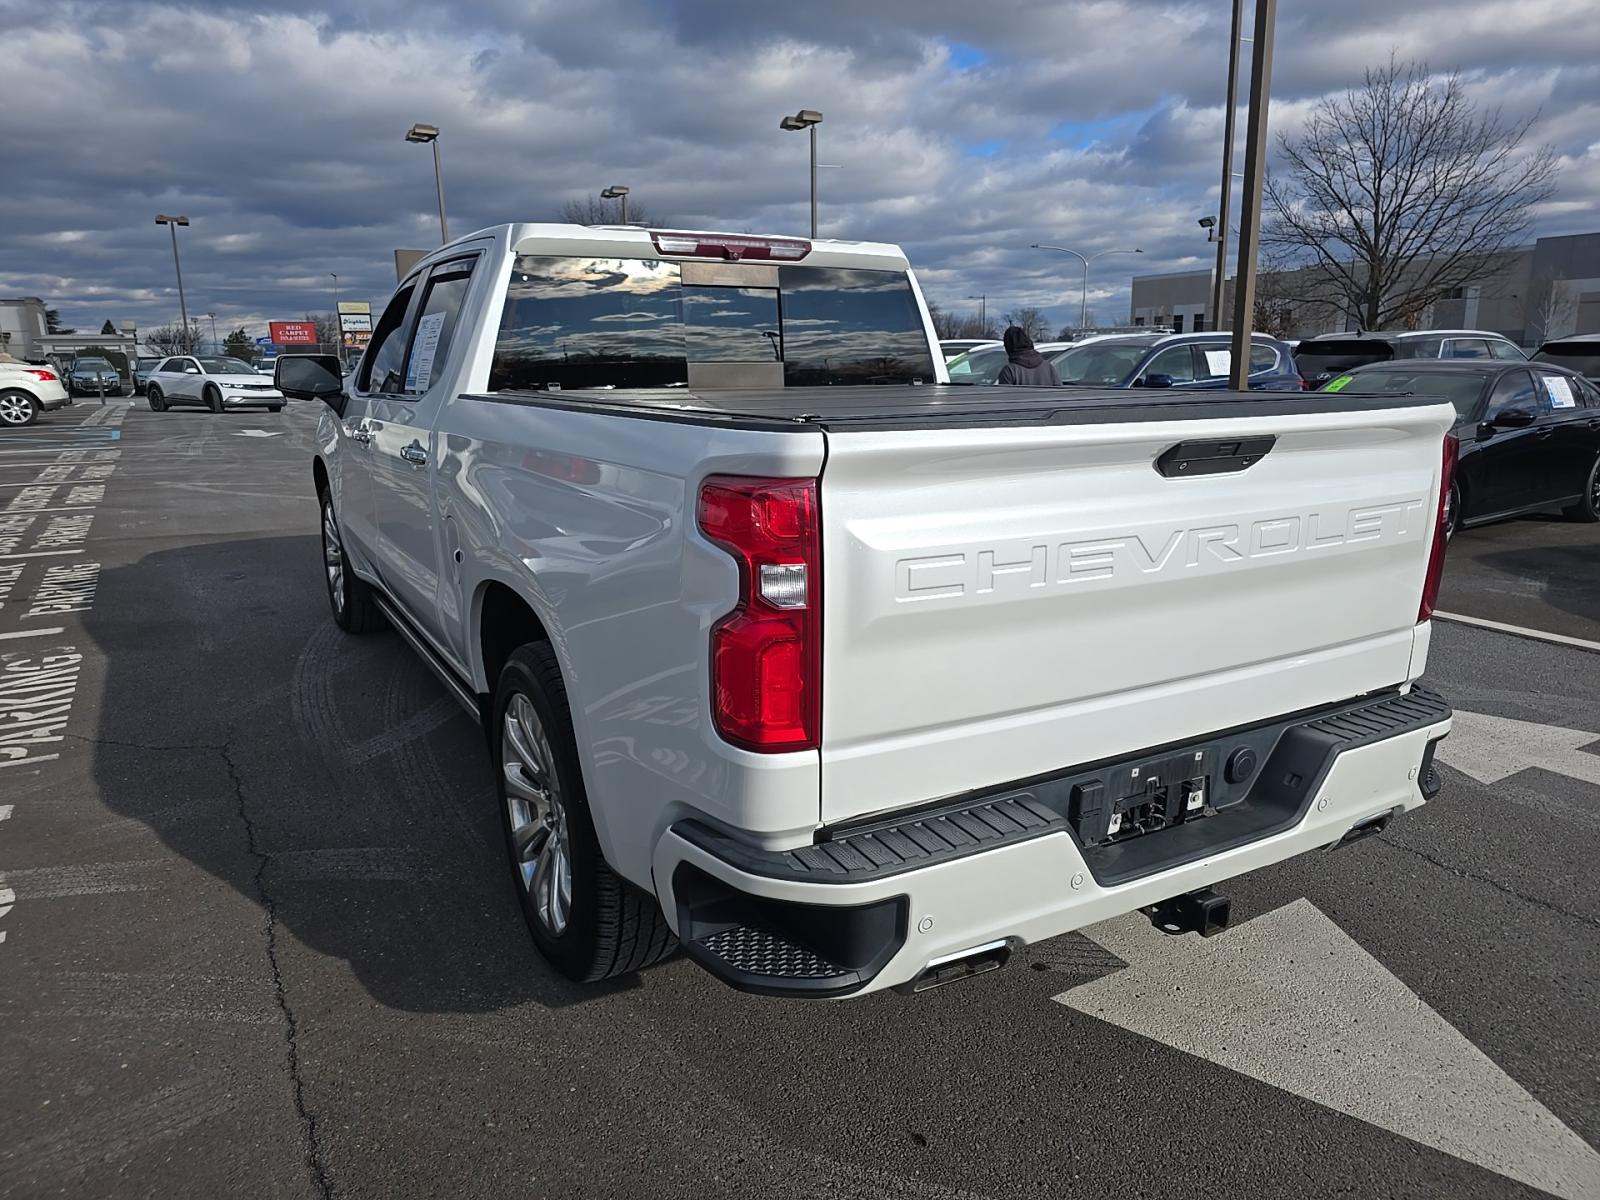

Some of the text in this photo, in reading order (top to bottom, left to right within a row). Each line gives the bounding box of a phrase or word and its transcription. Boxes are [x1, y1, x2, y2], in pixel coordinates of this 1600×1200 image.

[24, 563, 101, 619] PARKING
[895, 499, 1423, 603] CHEVROLET
[0, 653, 83, 768] PARKING
